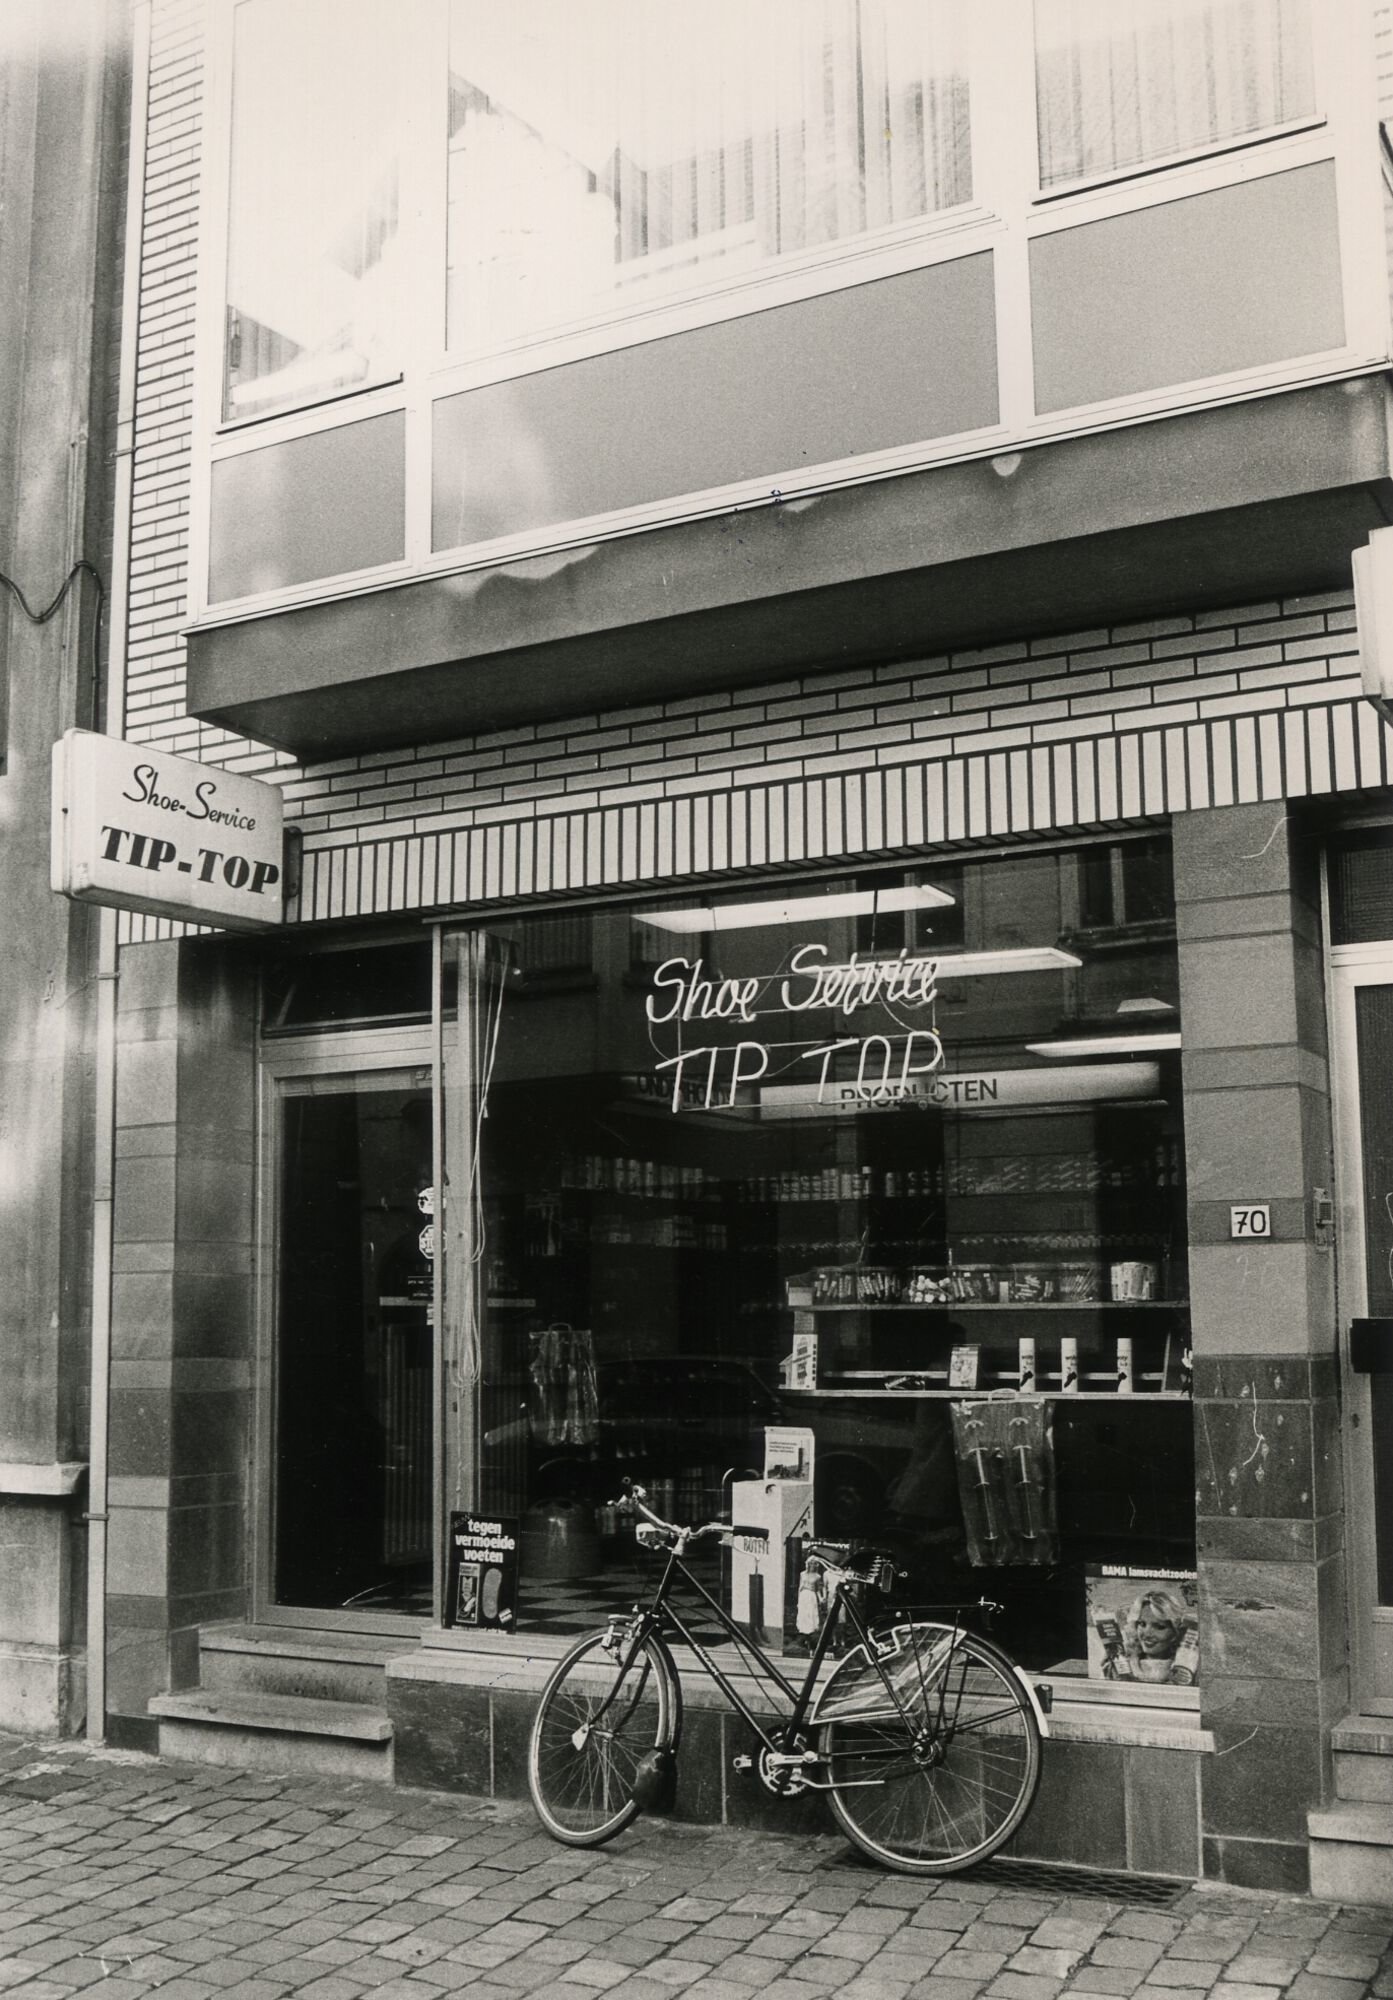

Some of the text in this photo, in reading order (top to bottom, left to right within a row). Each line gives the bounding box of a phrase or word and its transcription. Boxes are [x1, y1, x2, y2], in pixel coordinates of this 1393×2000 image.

[122, 764, 256, 831] Shoe-Service
[100, 825, 279, 895] TIP-TOP
[646, 944, 938, 1023] Shoe Service
[655, 1031, 943, 1113] TIP TOP
[1233, 1210, 1267, 1234] 70
[467, 1519, 502, 1536] tegen
[455, 1535, 515, 1550] vermoeide
[463, 1549, 504, 1563] voeten
[1101, 1565, 1127, 1577] BAMA
